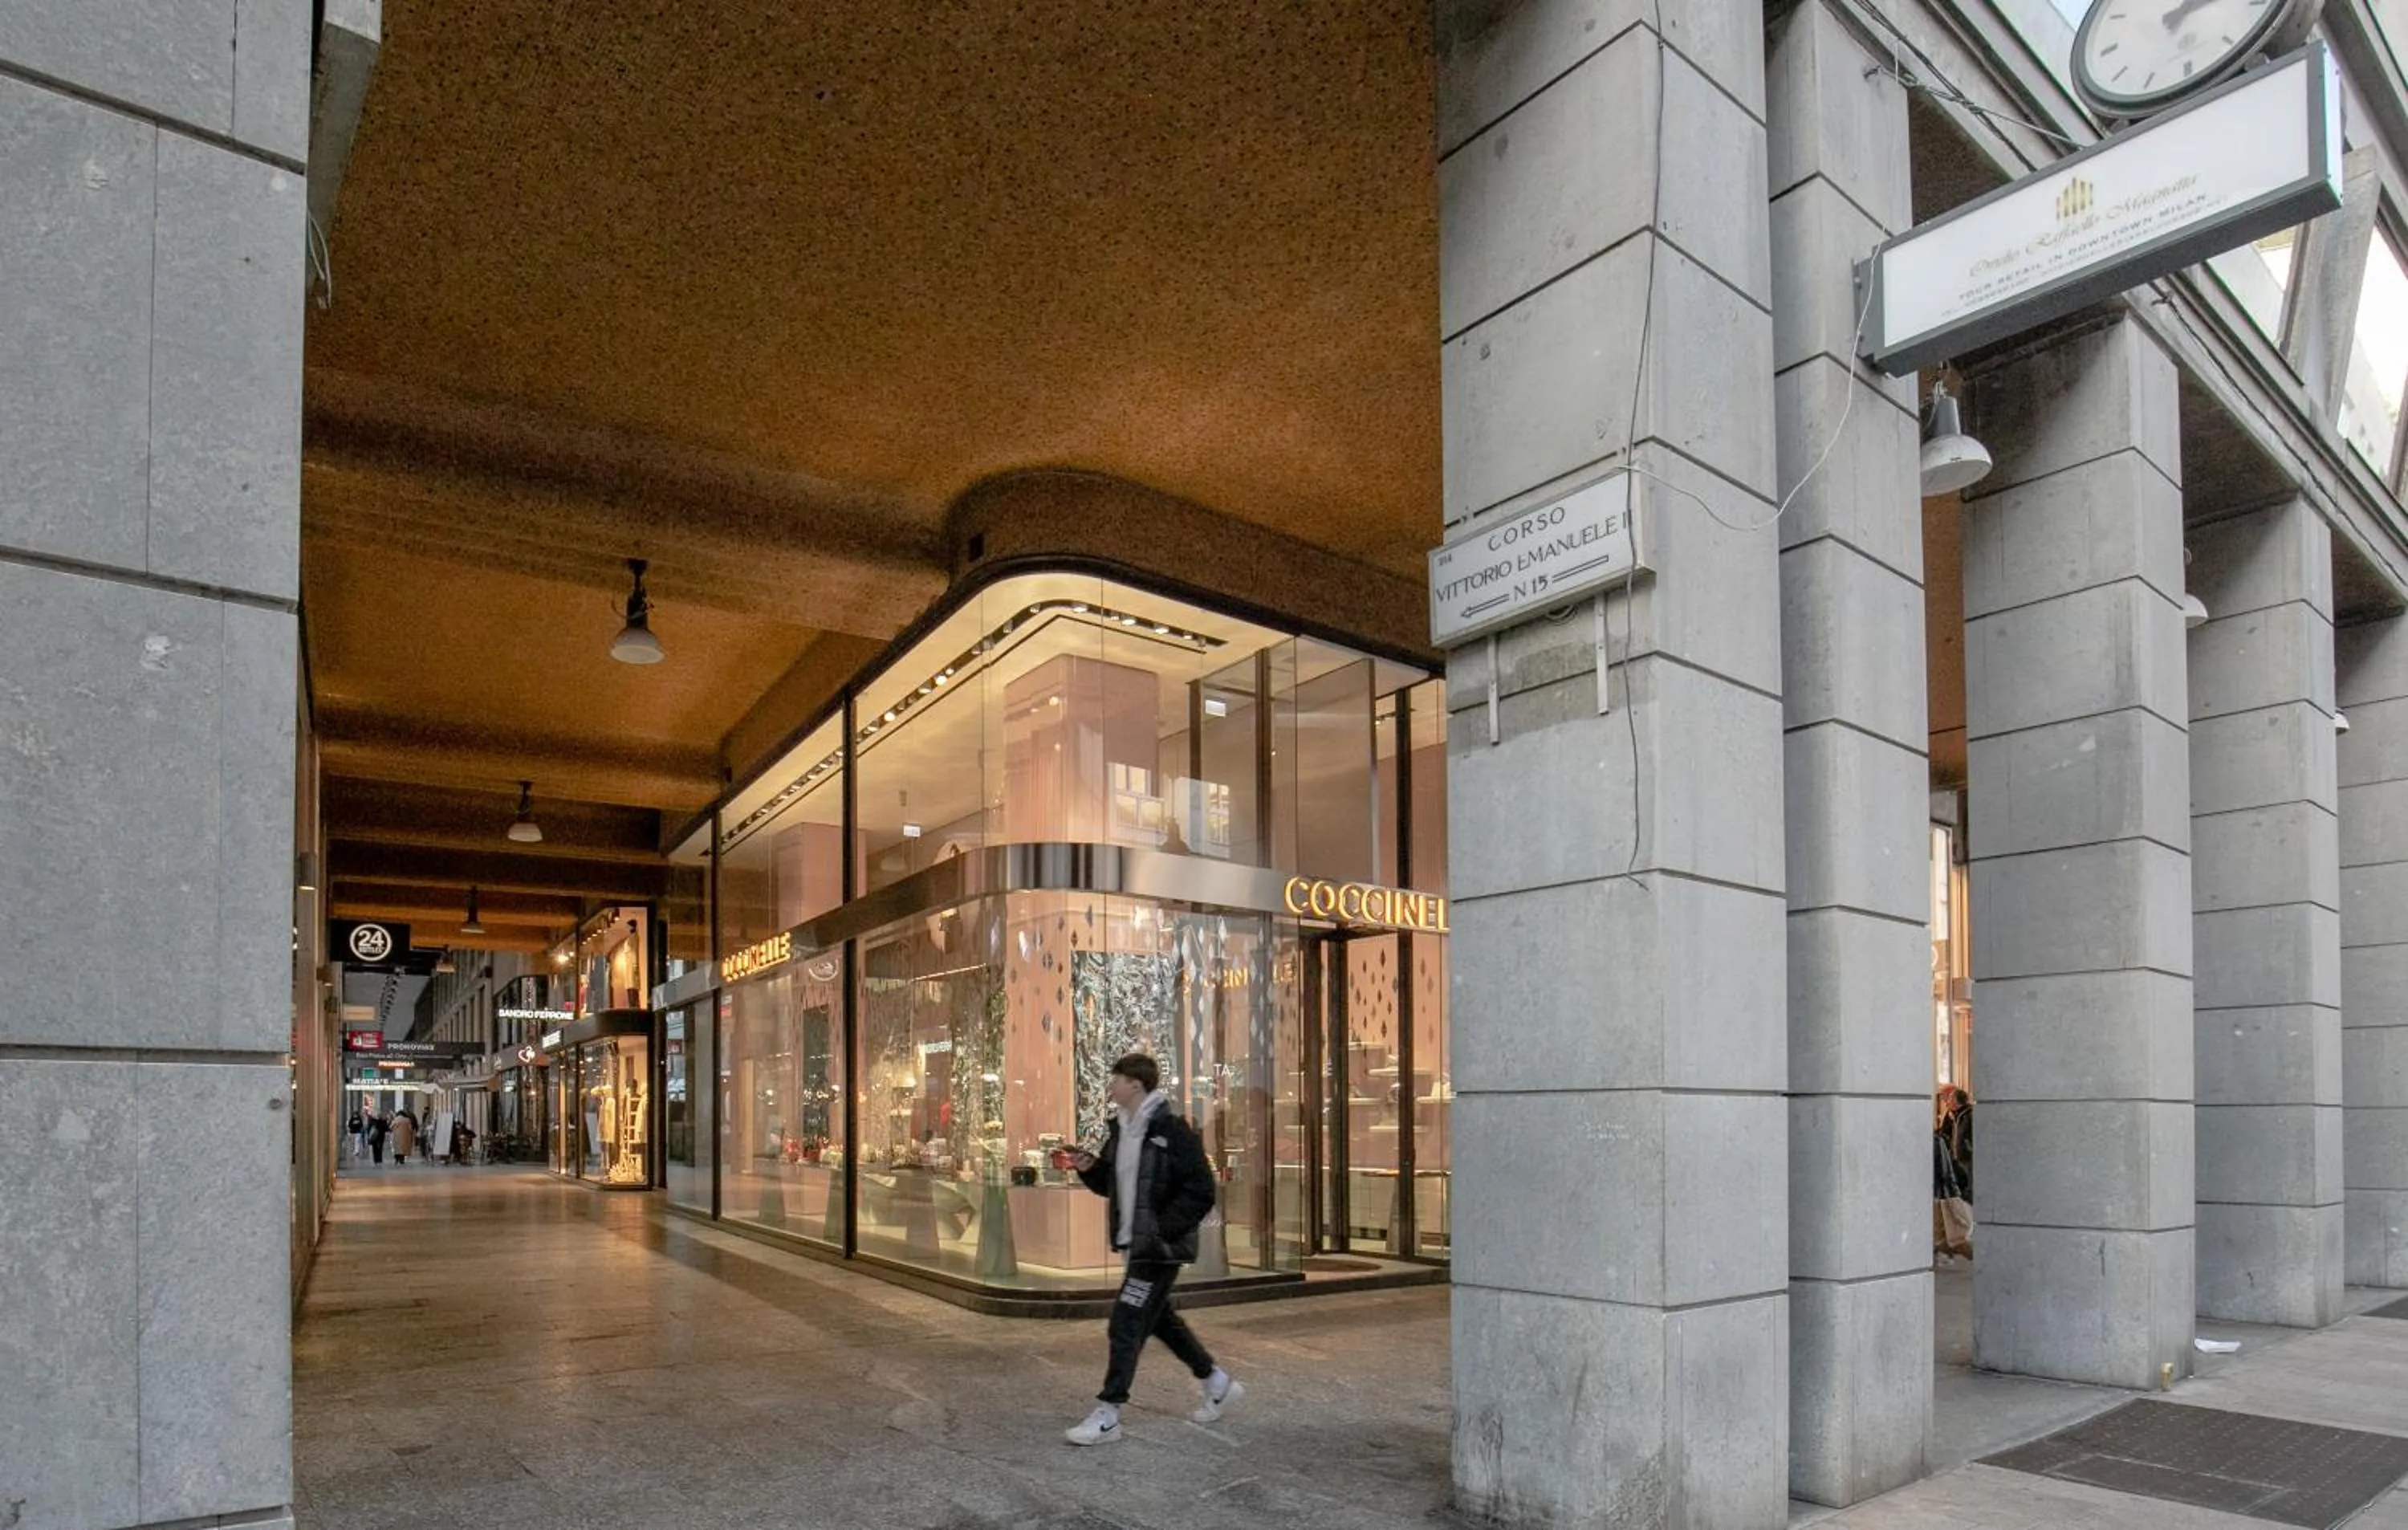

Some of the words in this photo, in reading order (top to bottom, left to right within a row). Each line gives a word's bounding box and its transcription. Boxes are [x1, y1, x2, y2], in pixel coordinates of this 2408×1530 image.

[2048, 254, 2063, 264] IN
[2068, 217, 2152, 255] DOWNTOWN
[2159, 193, 2207, 217] MILAN
[1488, 506, 1566, 551] CORSO
[1436, 560, 1512, 603] VITTORIO
[1518, 515, 1617, 571] EMANUELE
[1515, 581, 1526, 601] N
[1532, 574, 1548, 595] 15
[359, 930, 384, 947] 24
